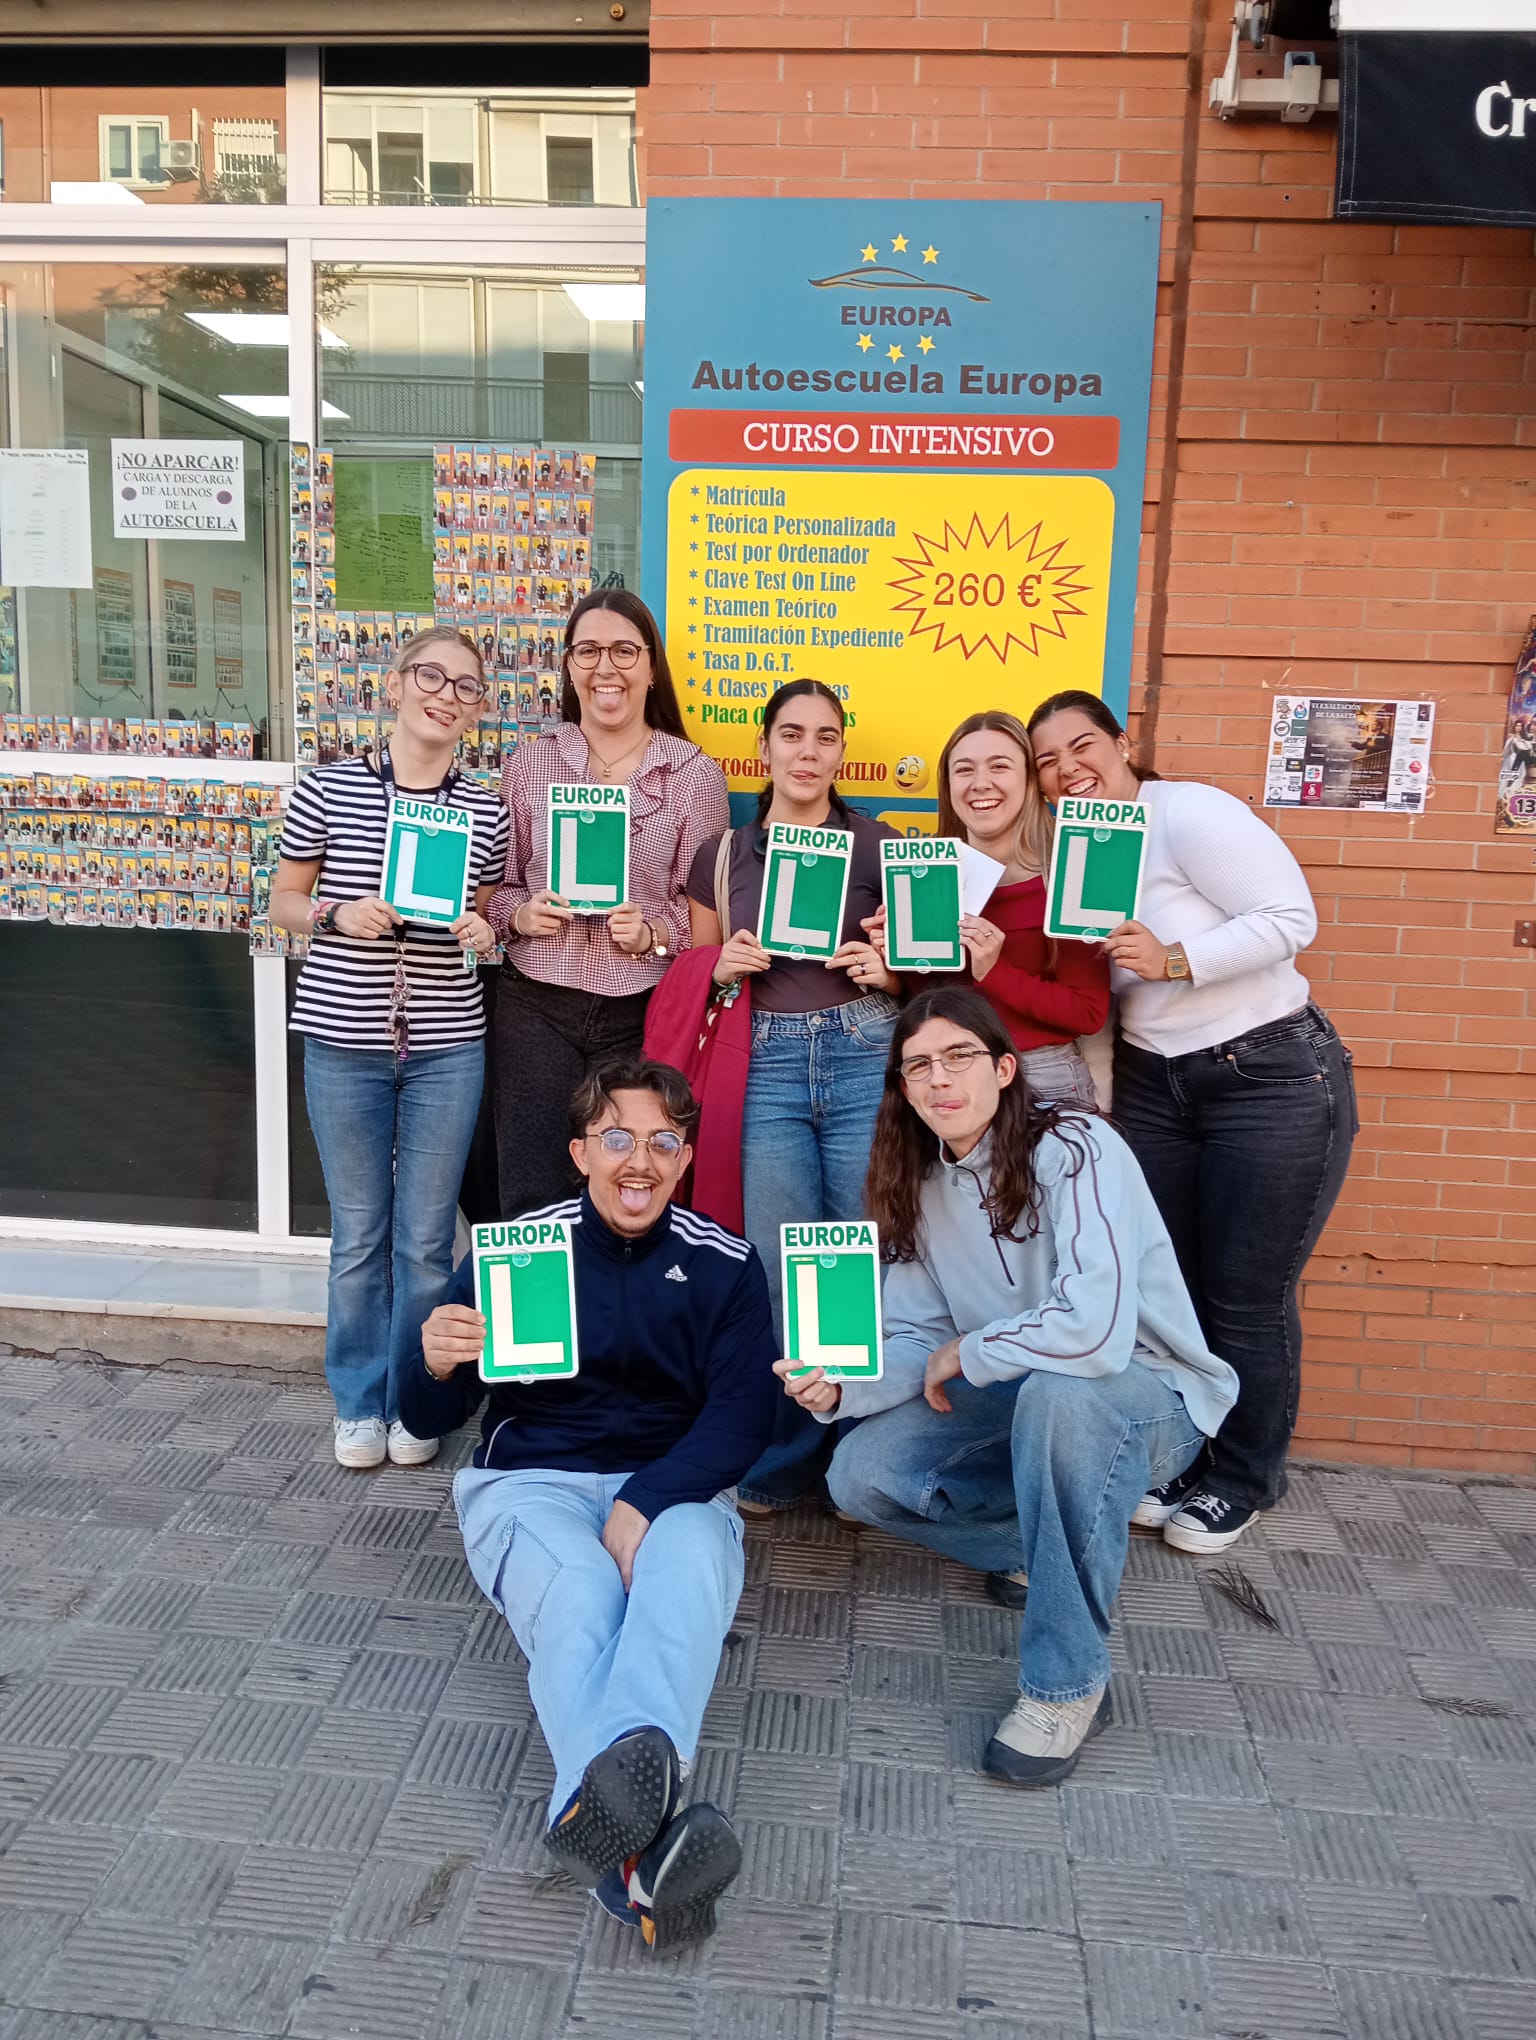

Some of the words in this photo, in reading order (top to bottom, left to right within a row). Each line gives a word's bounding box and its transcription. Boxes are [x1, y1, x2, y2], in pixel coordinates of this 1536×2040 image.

[1475, 80, 1536, 137] Cr
[841, 305, 952, 327] EUROPA
[691, 360, 944, 394] Autoescuela
[959, 365, 1102, 403] Europa
[743, 423, 859, 454] CURSO
[869, 425, 1054, 457] INTENSIVO
[117, 453, 147, 470] ¡NO
[151, 454, 239, 471] APARCAR!
[123, 472, 161, 483] CARGA
[163, 473, 170, 483] Y
[174, 474, 232, 485] DESCARGA
[141, 486, 156, 496] DE
[158, 487, 212, 498] ALUMNOS
[706, 485, 786, 508] Matrícula
[165, 500, 179, 510] DE
[183, 501, 197, 511] LA
[120, 514, 238, 530] AUTOESCUELA
[706, 513, 768, 536] Teórica
[774, 514, 896, 538] Personalizada
[705, 541, 738, 563] Test
[743, 546, 772, 565] por
[777, 543, 869, 565] Ordenador
[704, 569, 749, 590] Clave
[755, 570, 787, 591] Test
[792, 571, 815, 592] On
[820, 572, 856, 592] Line
[933, 573, 1004, 607] 260
[1017, 574, 1042, 608] €
[703, 597, 769, 618] Examen
[775, 596, 837, 620] Teórico
[703, 623, 806, 646] Tramitación
[811, 626, 904, 649] Expediente
[703, 651, 741, 672] Tasa
[745, 652, 795, 673] D.G.T.
[702, 678, 712, 697] 4
[718, 678, 767, 698] Clases
[701, 704, 748, 724] Placa
[551, 786, 626, 806] EUROPA
[393, 800, 469, 828] EUROPA
[1062, 800, 1147, 825] EUROPA
[772, 826, 849, 853] EUROPA
[883, 841, 958, 860] EUROPA
[559, 817, 617, 901] L
[393, 830, 454, 916] L
[1059, 836, 1126, 928] L
[770, 858, 830, 949] L
[893, 874, 954, 959] L
[476, 1224, 567, 1248] EUROPA
[785, 1225, 873, 1247] EUROPA
[489, 1264, 564, 1367] L
[795, 1265, 870, 1366] L
